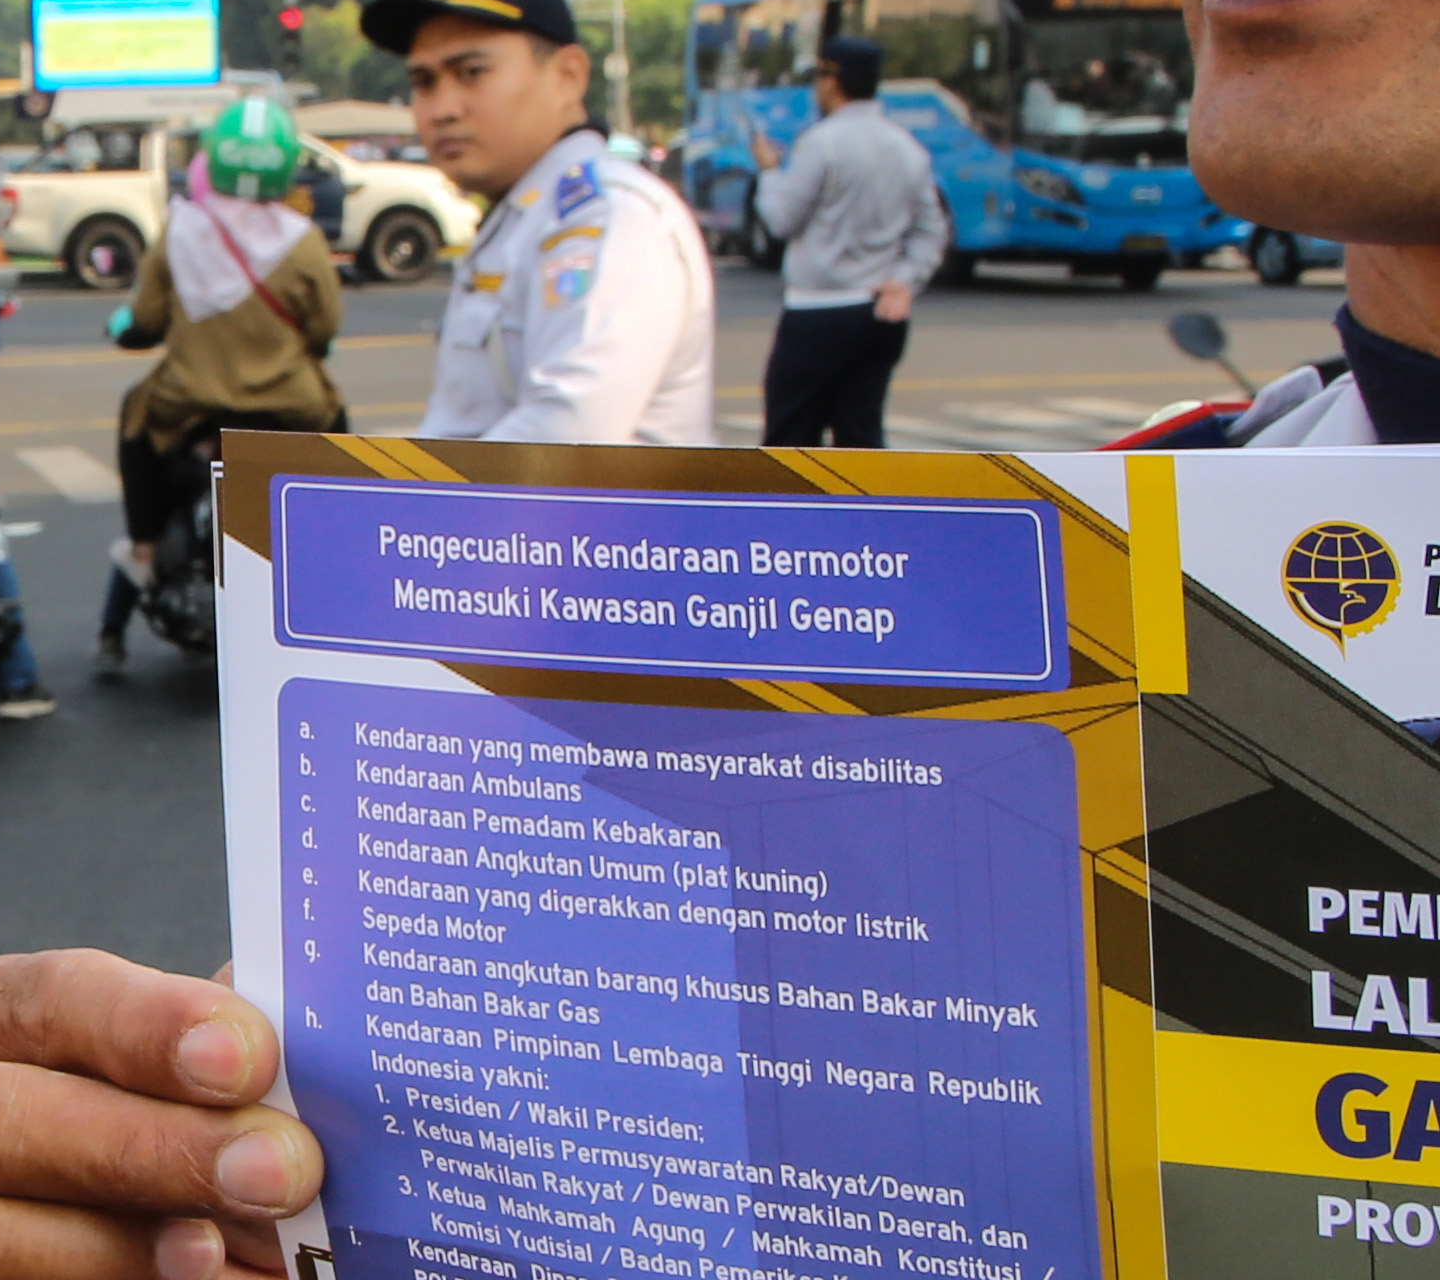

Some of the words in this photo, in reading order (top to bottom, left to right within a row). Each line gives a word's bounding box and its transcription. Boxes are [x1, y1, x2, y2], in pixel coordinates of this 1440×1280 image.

[379, 525, 563, 569] Pengecualian
[571, 535, 740, 574] Kendaraan
[749, 541, 910, 579] Bermotor
[394, 578, 531, 618] Memasuki
[540, 587, 676, 626] Kawasan
[686, 594, 778, 639] Ganjil
[789, 597, 895, 644] Genap
[355, 721, 463, 756] Kendaraan
[468, 738, 523, 768] yang
[529, 741, 649, 770] membawa
[655, 751, 804, 781] masyarakat
[811, 754, 943, 786] disabilitas
[356, 758, 465, 793] Kendaraan
[470, 770, 582, 803] Ambulans
[357, 795, 467, 830] Kendaraan
[472, 807, 586, 841] Pemadam
[592, 817, 722, 851] Kebakaran
[358, 832, 469, 867] Kendaraan
[475, 845, 583, 879] Angkutan
[589, 854, 666, 884] Umum
[673, 860, 729, 893] (plat
[734, 865, 828, 902] kuning)
[358, 868, 470, 904] Kendaraan
[474, 887, 532, 917] yang
[538, 888, 671, 922] digerakkan
[678, 899, 766, 934] dengan
[773, 909, 848, 935] motor
[855, 912, 930, 942] listrik
[362, 905, 440, 938] Sepeda
[445, 915, 507, 944] Motor
[363, 942, 478, 977] Kendaraan
[484, 959, 590, 988] angkutan
[595, 966, 679, 1003] barang
[685, 973, 771, 1005] khusus
[777, 981, 855, 1012] Bahan
[862, 988, 938, 1019] Bakar
[945, 996, 1039, 1033] Minyak
[366, 979, 405, 1005] dan
[409, 983, 478, 1013] Bahan
[483, 991, 551, 1020] Bakar
[557, 998, 601, 1025] Gas
[365, 1013, 482, 1049] Kendaraan
[493, 1027, 601, 1062] Pimpinan
[612, 1039, 724, 1079] Lembaga
[735, 1051, 812, 1088] Tinggi
[825, 1060, 915, 1095] Negara
[928, 1070, 1043, 1106] Republik
[370, 1049, 475, 1083] Indonesia
[479, 1065, 550, 1091] yakni:
[405, 1086, 502, 1120] Presiden
[526, 1101, 589, 1130] Wakil
[595, 1108, 705, 1144] Presiden;
[412, 1117, 475, 1148] Ketua
[477, 1129, 555, 1161] Majelis
[560, 1139, 774, 1186] Permusyawaratan
[779, 1164, 965, 1208] Rakyat/Dewan
[420, 1148, 538, 1191] Perwakilan
[541, 1170, 625, 1205] Rakyat
[651, 1183, 730, 1215] Dewan
[736, 1193, 872, 1232] Perwakilan
[878, 1210, 974, 1246] Daerah,
[981, 1224, 1028, 1251] dan
[426, 1179, 487, 1212] Ketua
[498, 1194, 616, 1235] Mahkamah
[631, 1215, 706, 1252] Agung
[751, 1229, 883, 1268] Mahkamah
[407, 1237, 518, 1280] Kendaraan
[430, 1211, 502, 1246] Komisi
[505, 1226, 593, 1263] Yudisial
[619, 1247, 693, 1278] Badan
